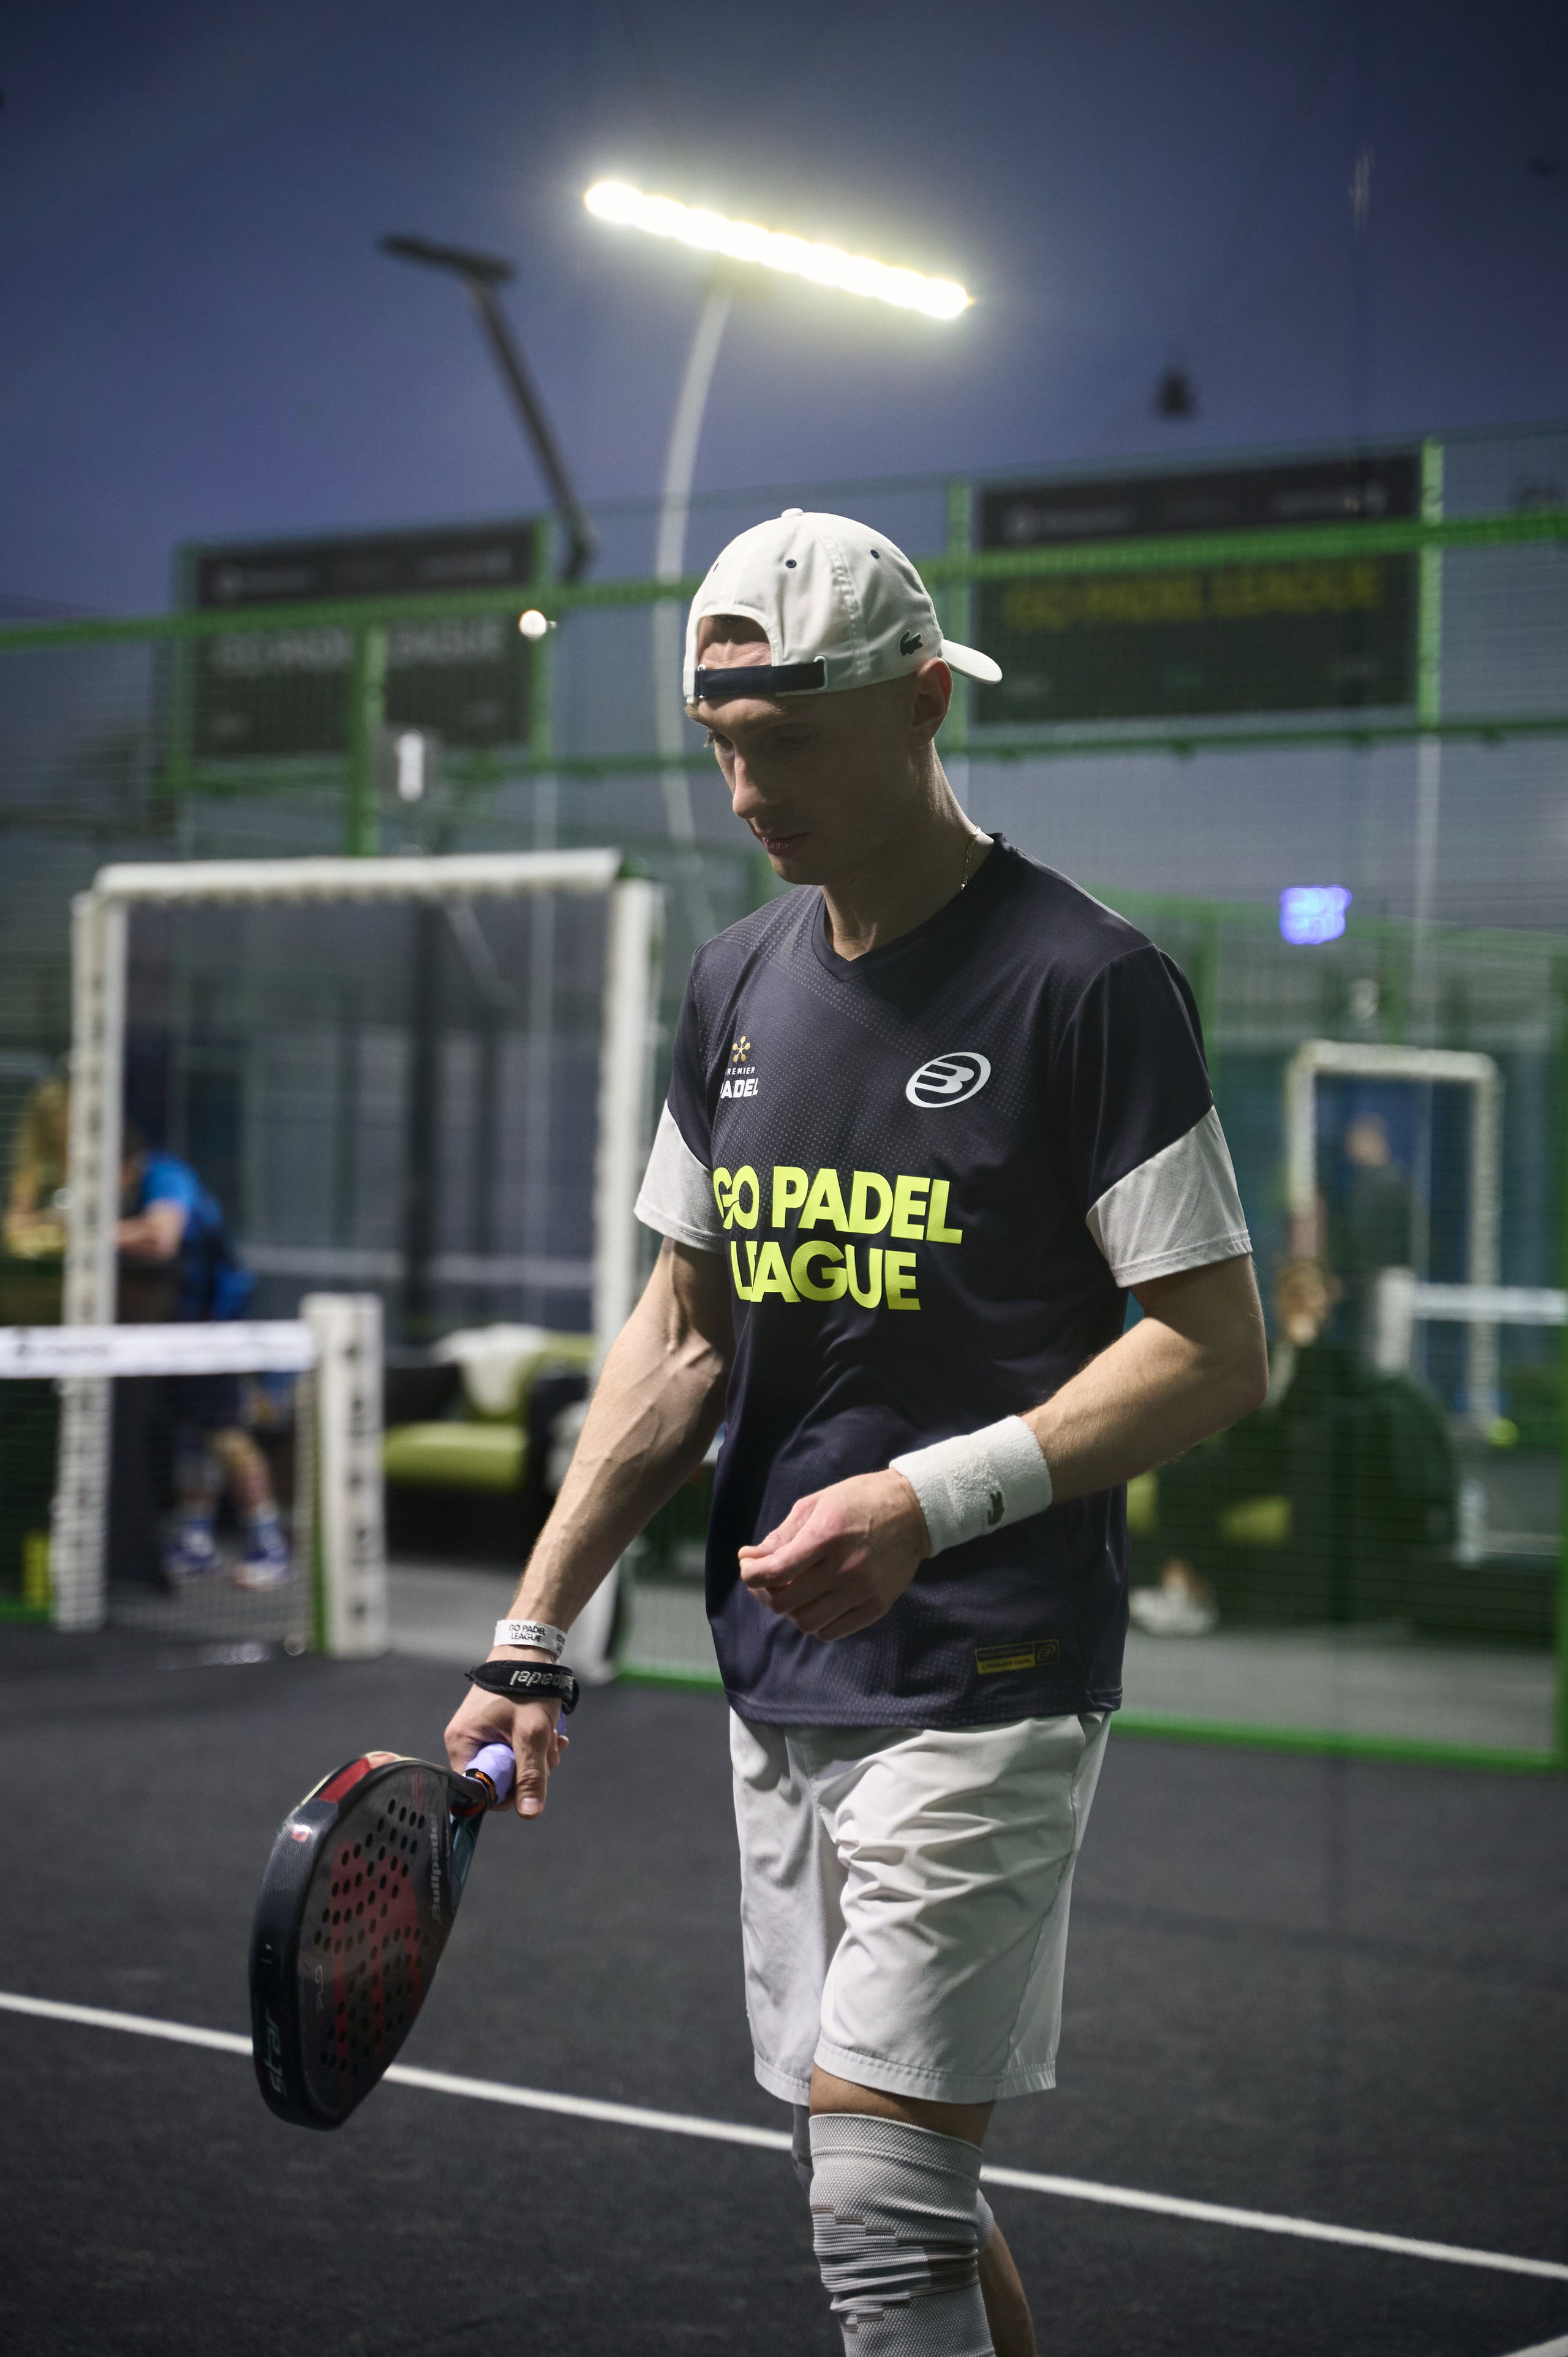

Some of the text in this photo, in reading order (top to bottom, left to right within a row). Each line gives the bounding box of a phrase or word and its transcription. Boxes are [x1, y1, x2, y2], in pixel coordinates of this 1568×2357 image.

[725, 1066, 755, 1076] REMIER
[720, 1077, 759, 1099] ADEL
[713, 1165, 963, 1245] GO PADEL
[522, 1624, 546, 1636] PADEL
[511, 1632, 542, 1643] LEAGUE
